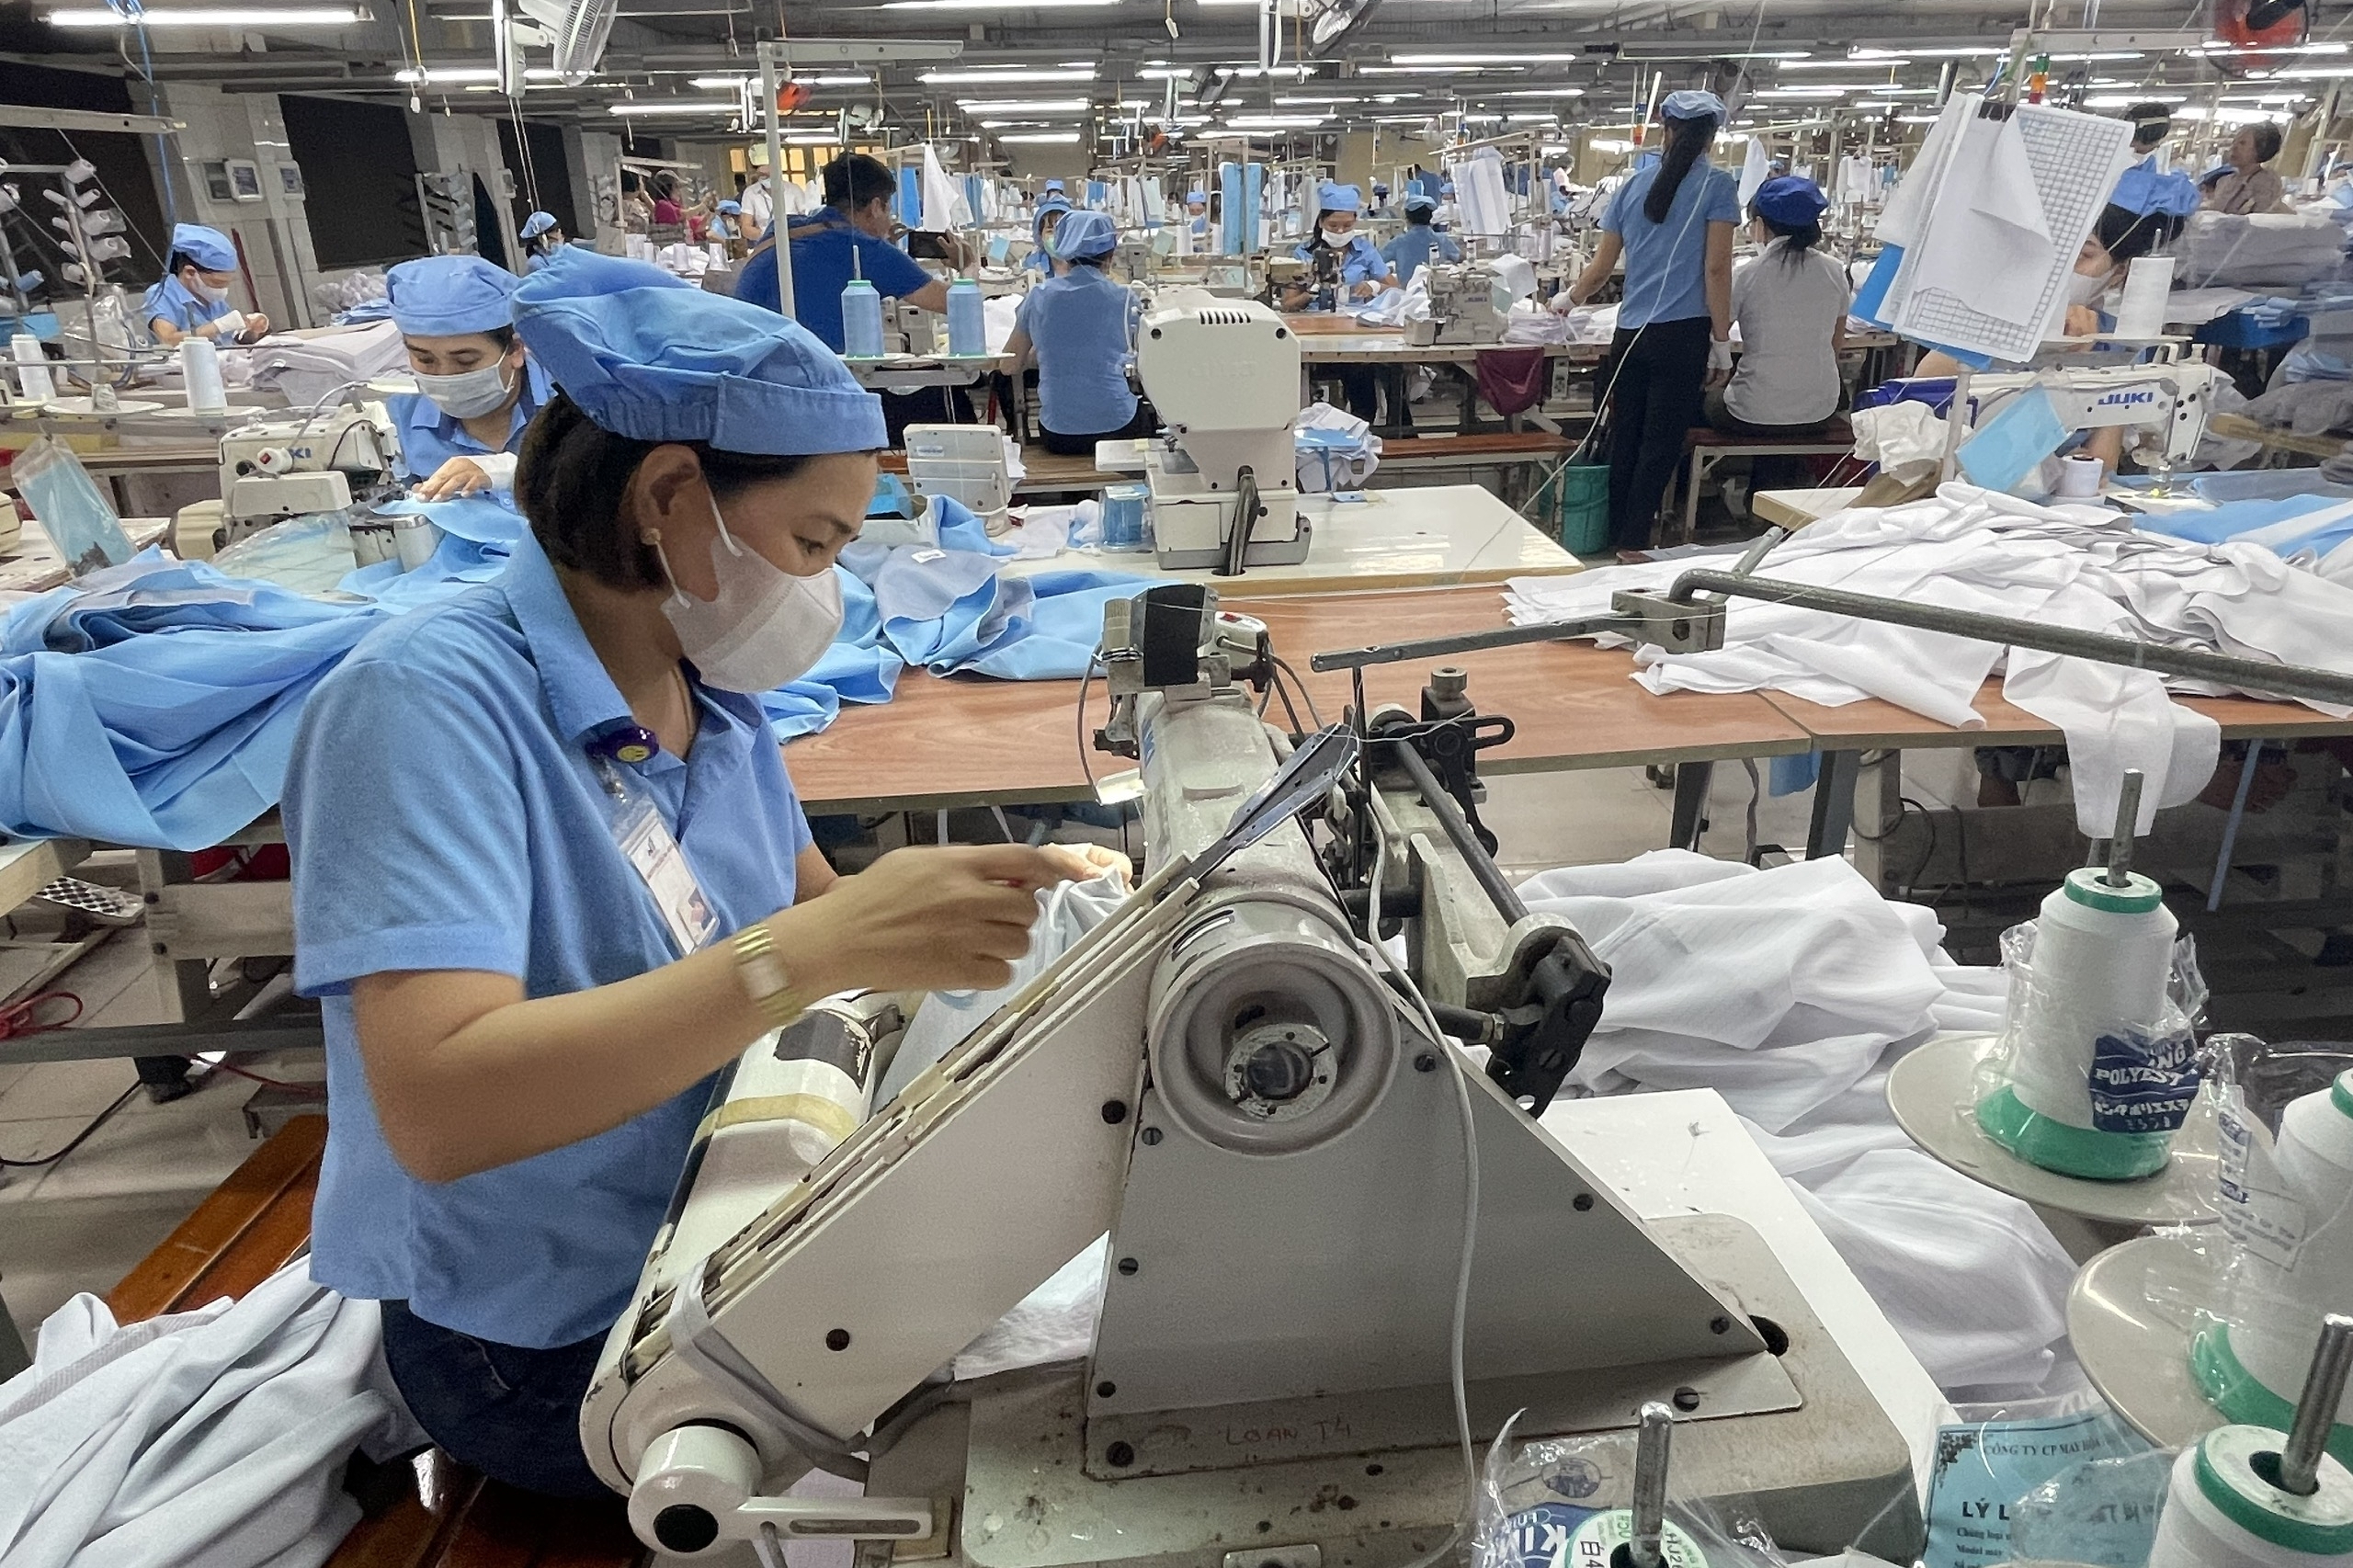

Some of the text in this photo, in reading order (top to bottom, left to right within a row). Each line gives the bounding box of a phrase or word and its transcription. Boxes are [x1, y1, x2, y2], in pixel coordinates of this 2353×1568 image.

[2097, 392, 2154, 405] JUKI
[1225, 1425, 1298, 1447] LOAN
[2023, 1444, 2039, 1456] TY
[1962, 1497, 1990, 1518] LÝ
